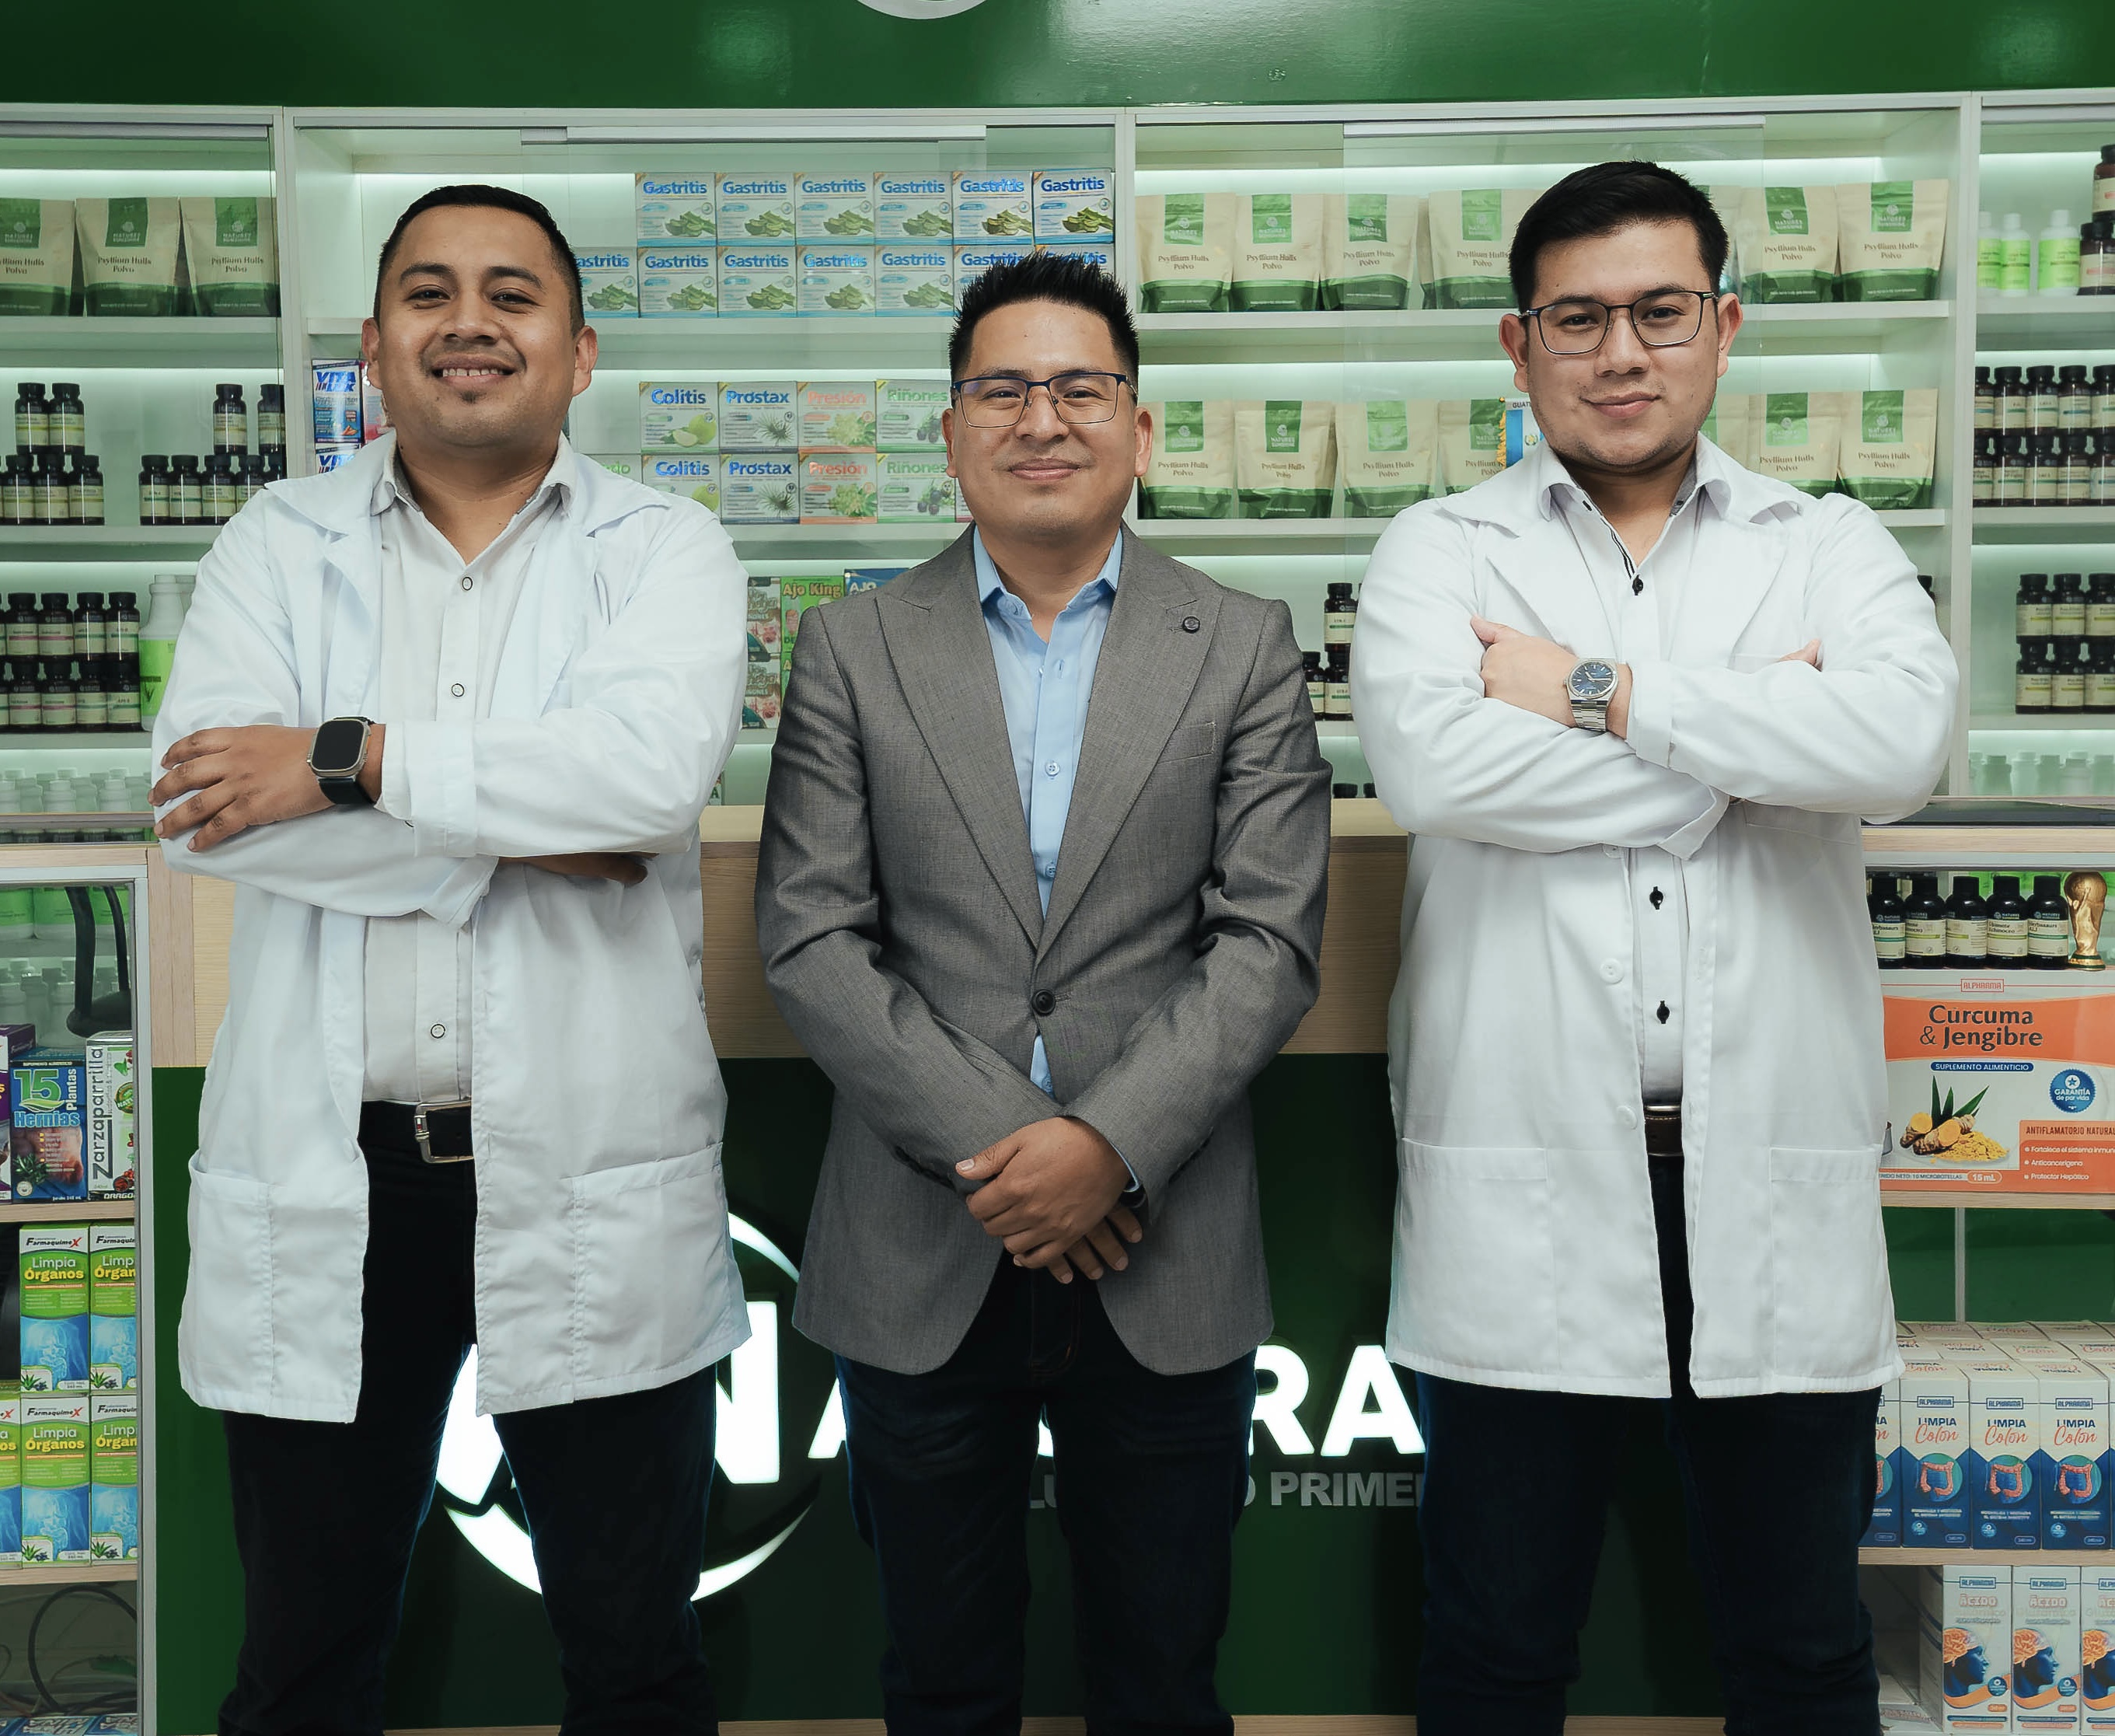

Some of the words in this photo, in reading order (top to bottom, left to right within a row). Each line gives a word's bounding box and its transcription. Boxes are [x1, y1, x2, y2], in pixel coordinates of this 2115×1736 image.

[644, 181, 707, 194] Gastritis
[723, 180, 787, 194] Gastritis
[802, 180, 866, 194] Gastritis
[881, 180, 945, 194] Gastritis
[961, 178, 1024, 193] Gastritis
[1041, 176, 1105, 192] Gastritis
[577, 253, 630, 267] astritis
[645, 255, 709, 268] Gastritis
[724, 254, 789, 267] Gastritis
[804, 253, 867, 267] Gastritis
[882, 253, 946, 267] Gastritis
[651, 389, 707, 404] Colitis
[726, 390, 790, 403] Prostax
[808, 390, 867, 404] Presión
[655, 461, 710, 476] Colitis
[729, 462, 792, 475] Prostax
[809, 461, 867, 475] Presión
[783, 583, 805, 598] Ajo
[809, 582, 841, 598] King
[1920, 1025, 1937, 1045] &
[1942, 1025, 2043, 1052] Jengibre
[13, 1069, 61, 1102] 15
[65, 1069, 77, 1111] Plantas
[14, 1111, 80, 1127] Hernias
[89, 1046, 113, 1179] Zarzaparrilla
[2026, 1126, 2084, 1135] ANTIFLAMATORIO
[32, 1256, 76, 1270] Limpia
[24, 1267, 84, 1282] Órganos
[1918, 1417, 1956, 1426] LIMPIA
[1988, 1419, 2026, 1427] LIMPIA
[2057, 1419, 2096, 1427] LIMPIA
[33, 1427, 76, 1441] Limpia
[25, 1437, 85, 1452] Órganos
[1270, 1472, 1427, 1507] PRIME
